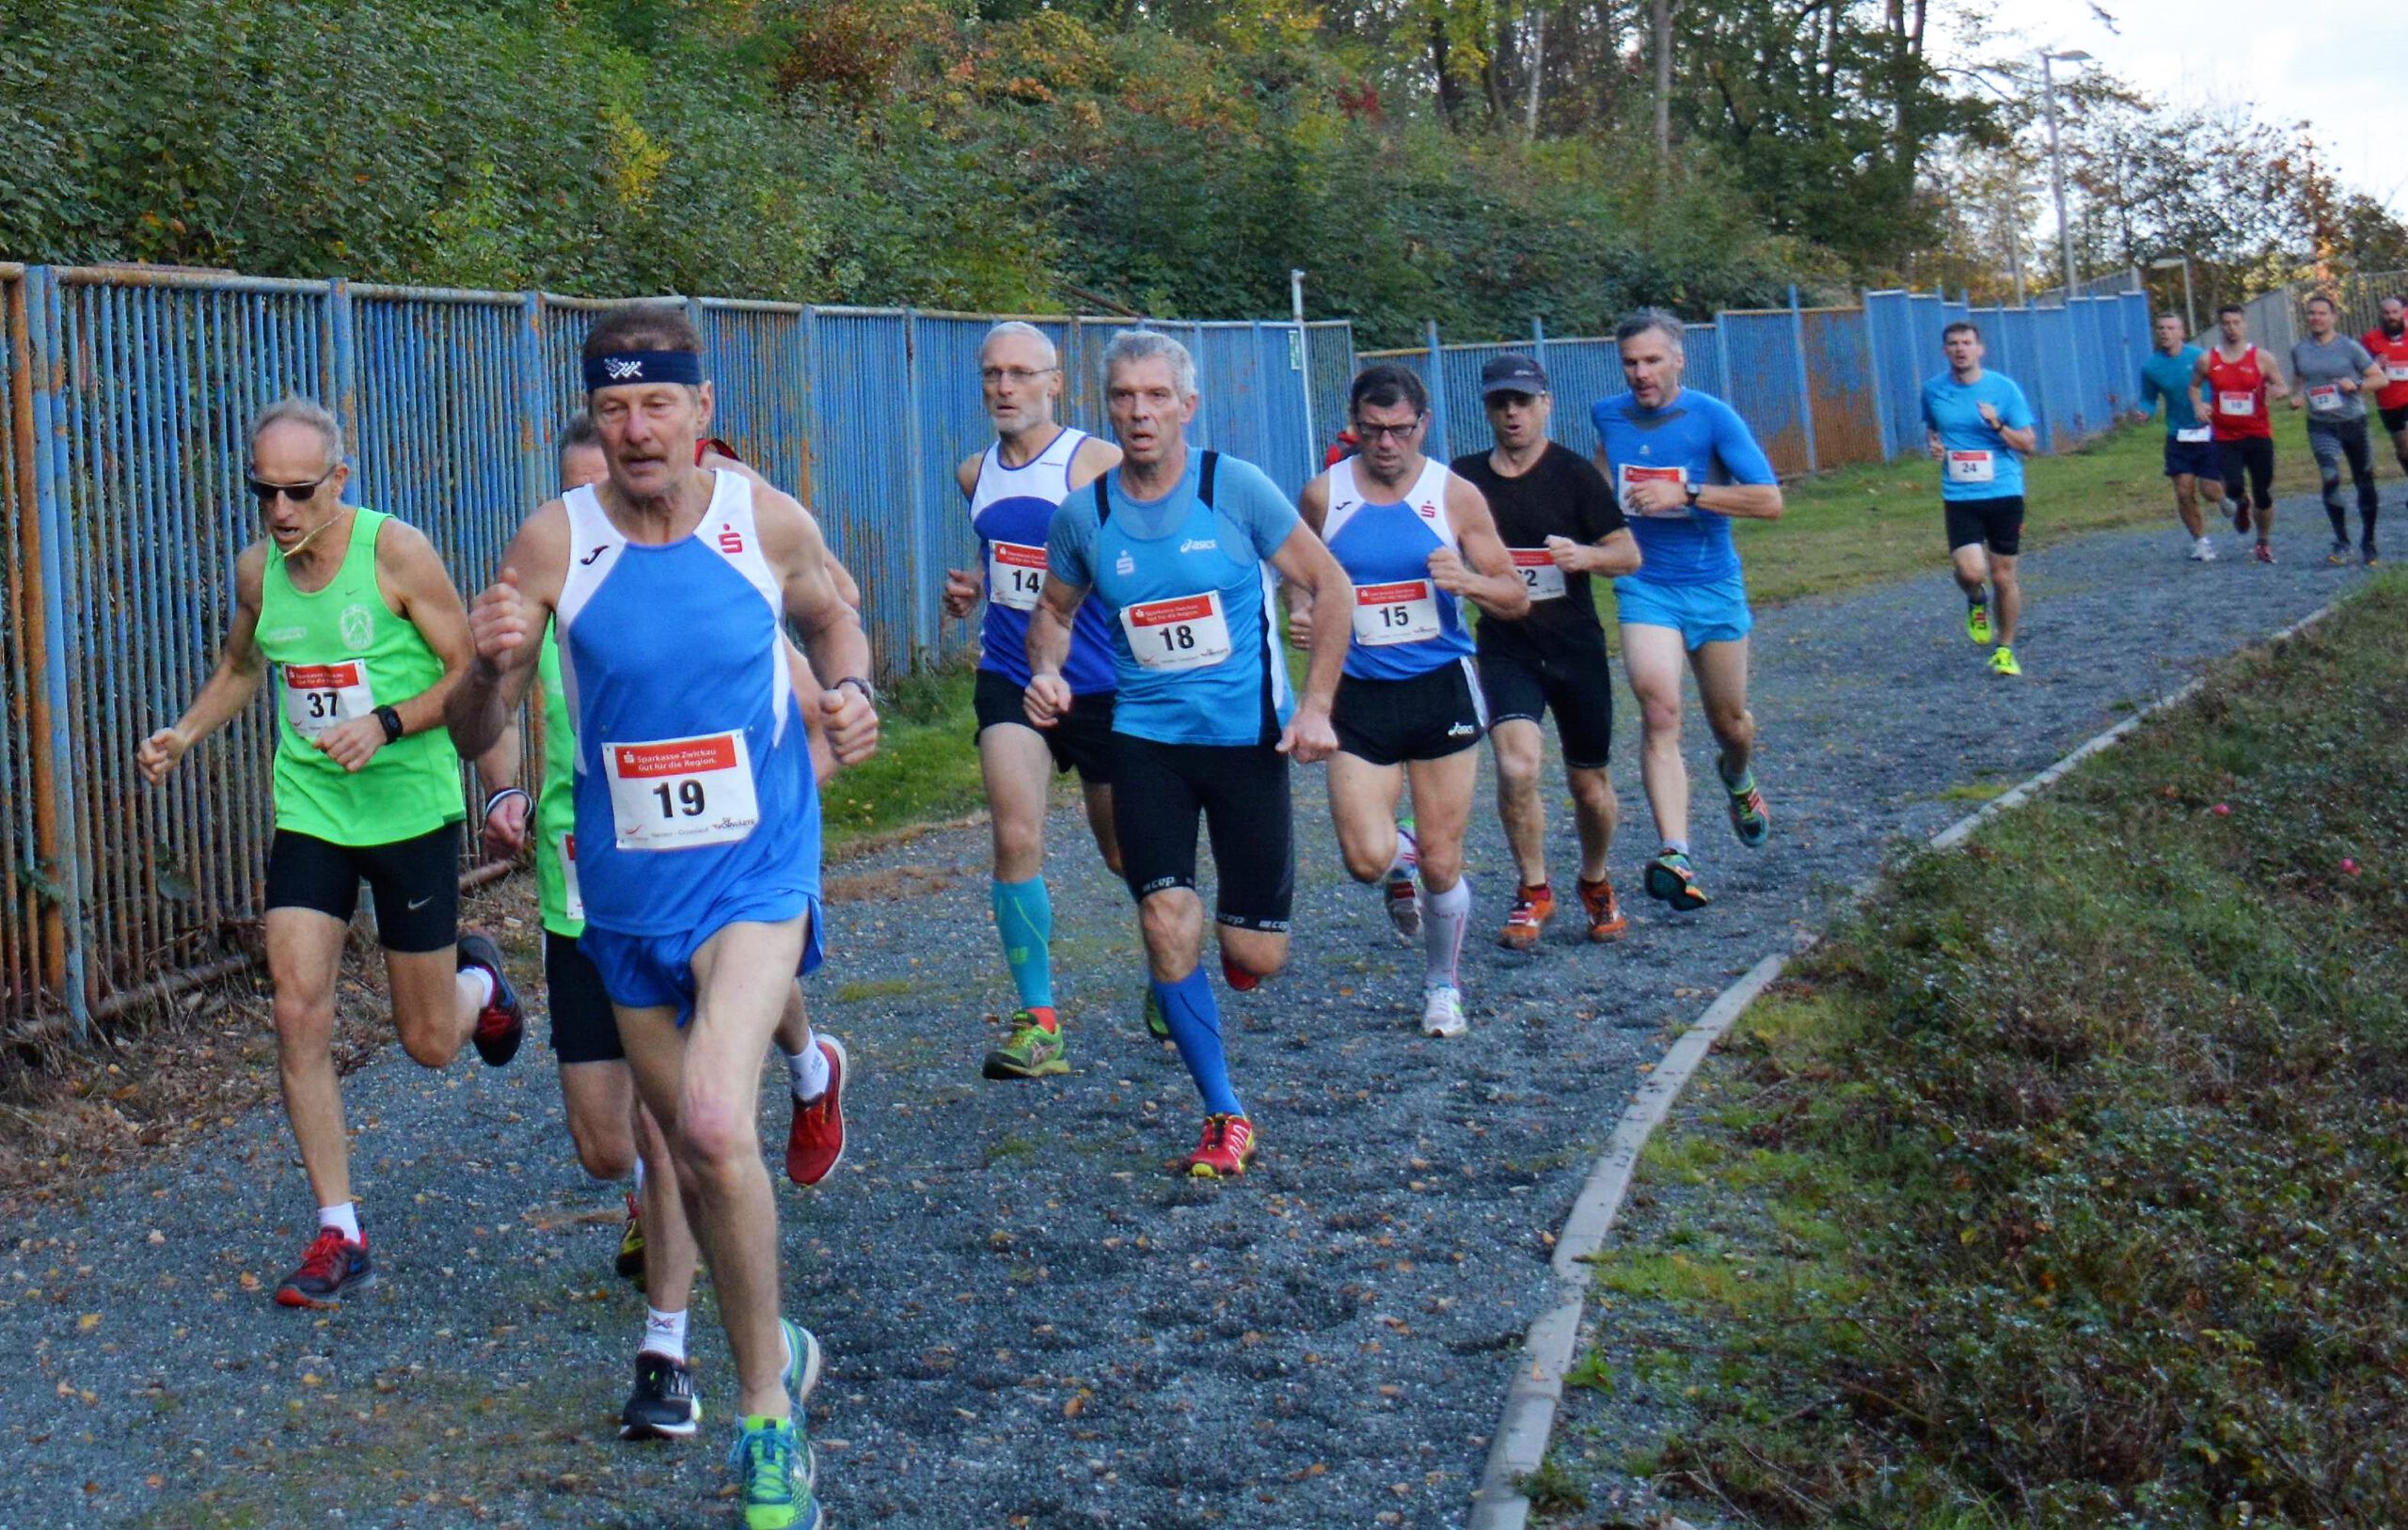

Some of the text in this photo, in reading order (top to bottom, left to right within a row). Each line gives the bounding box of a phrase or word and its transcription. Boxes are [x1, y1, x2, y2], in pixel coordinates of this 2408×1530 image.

[1012, 569, 1039, 593] 14
[1517, 569, 1538, 587] 2
[1379, 606, 1409, 627] 15
[1159, 624, 1195, 651] 18
[307, 691, 338, 718] 37
[637, 752, 679, 764] Sparkasse
[652, 779, 705, 818] 19
